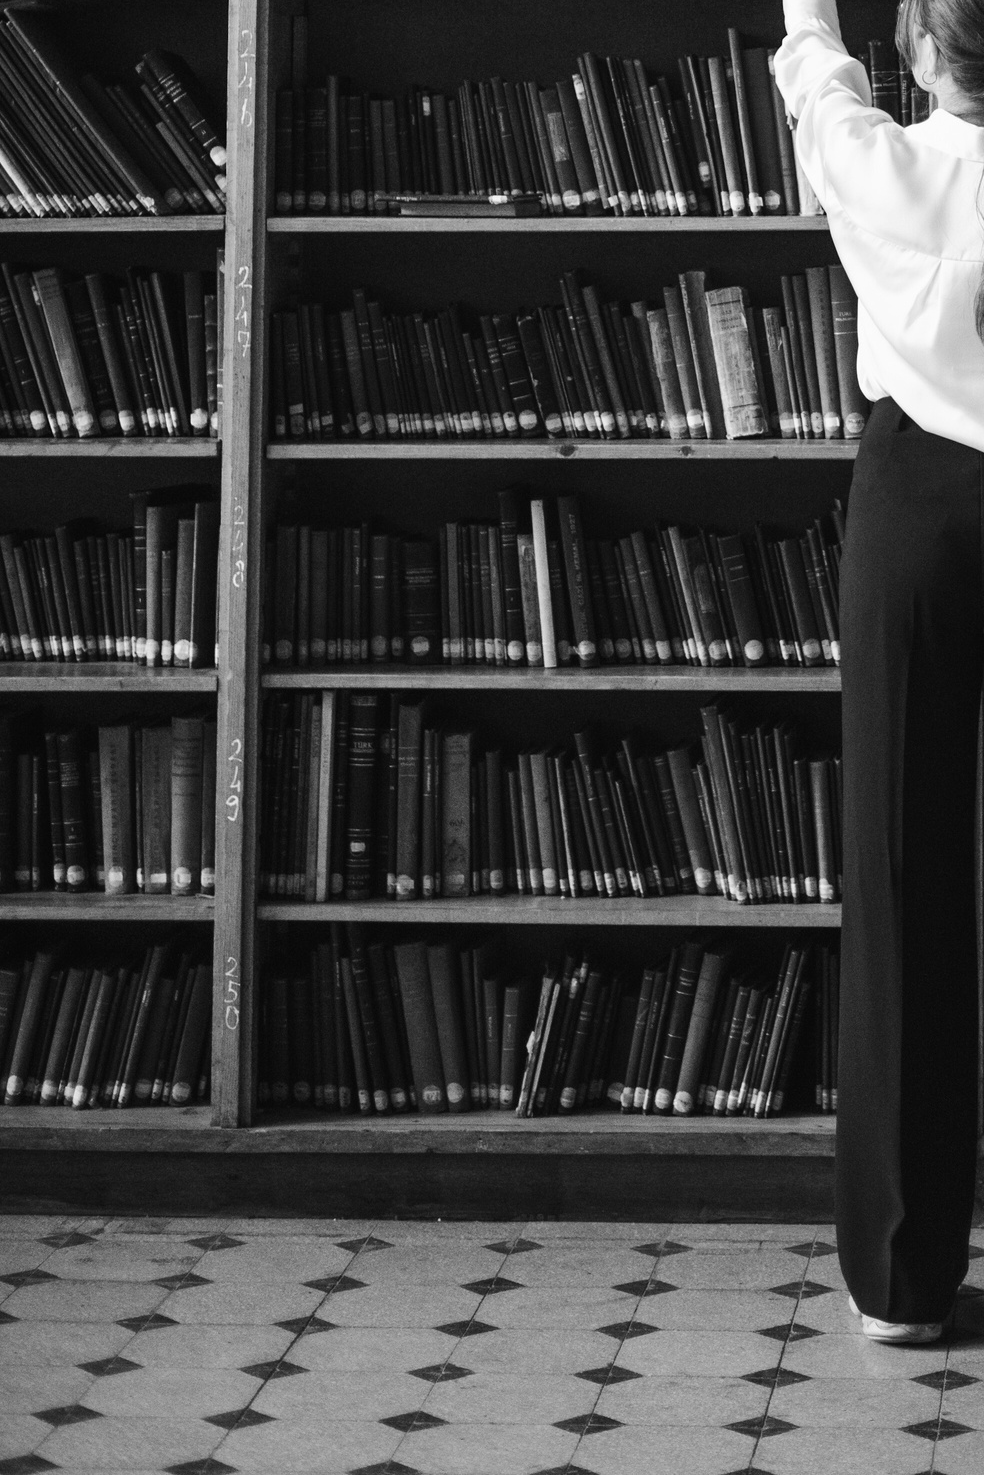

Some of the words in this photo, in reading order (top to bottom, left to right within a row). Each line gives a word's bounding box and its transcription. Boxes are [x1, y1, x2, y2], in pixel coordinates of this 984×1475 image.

[235, 266, 252, 357] 247
[226, 739, 243, 821] 249
[224, 956, 240, 1030] 250
